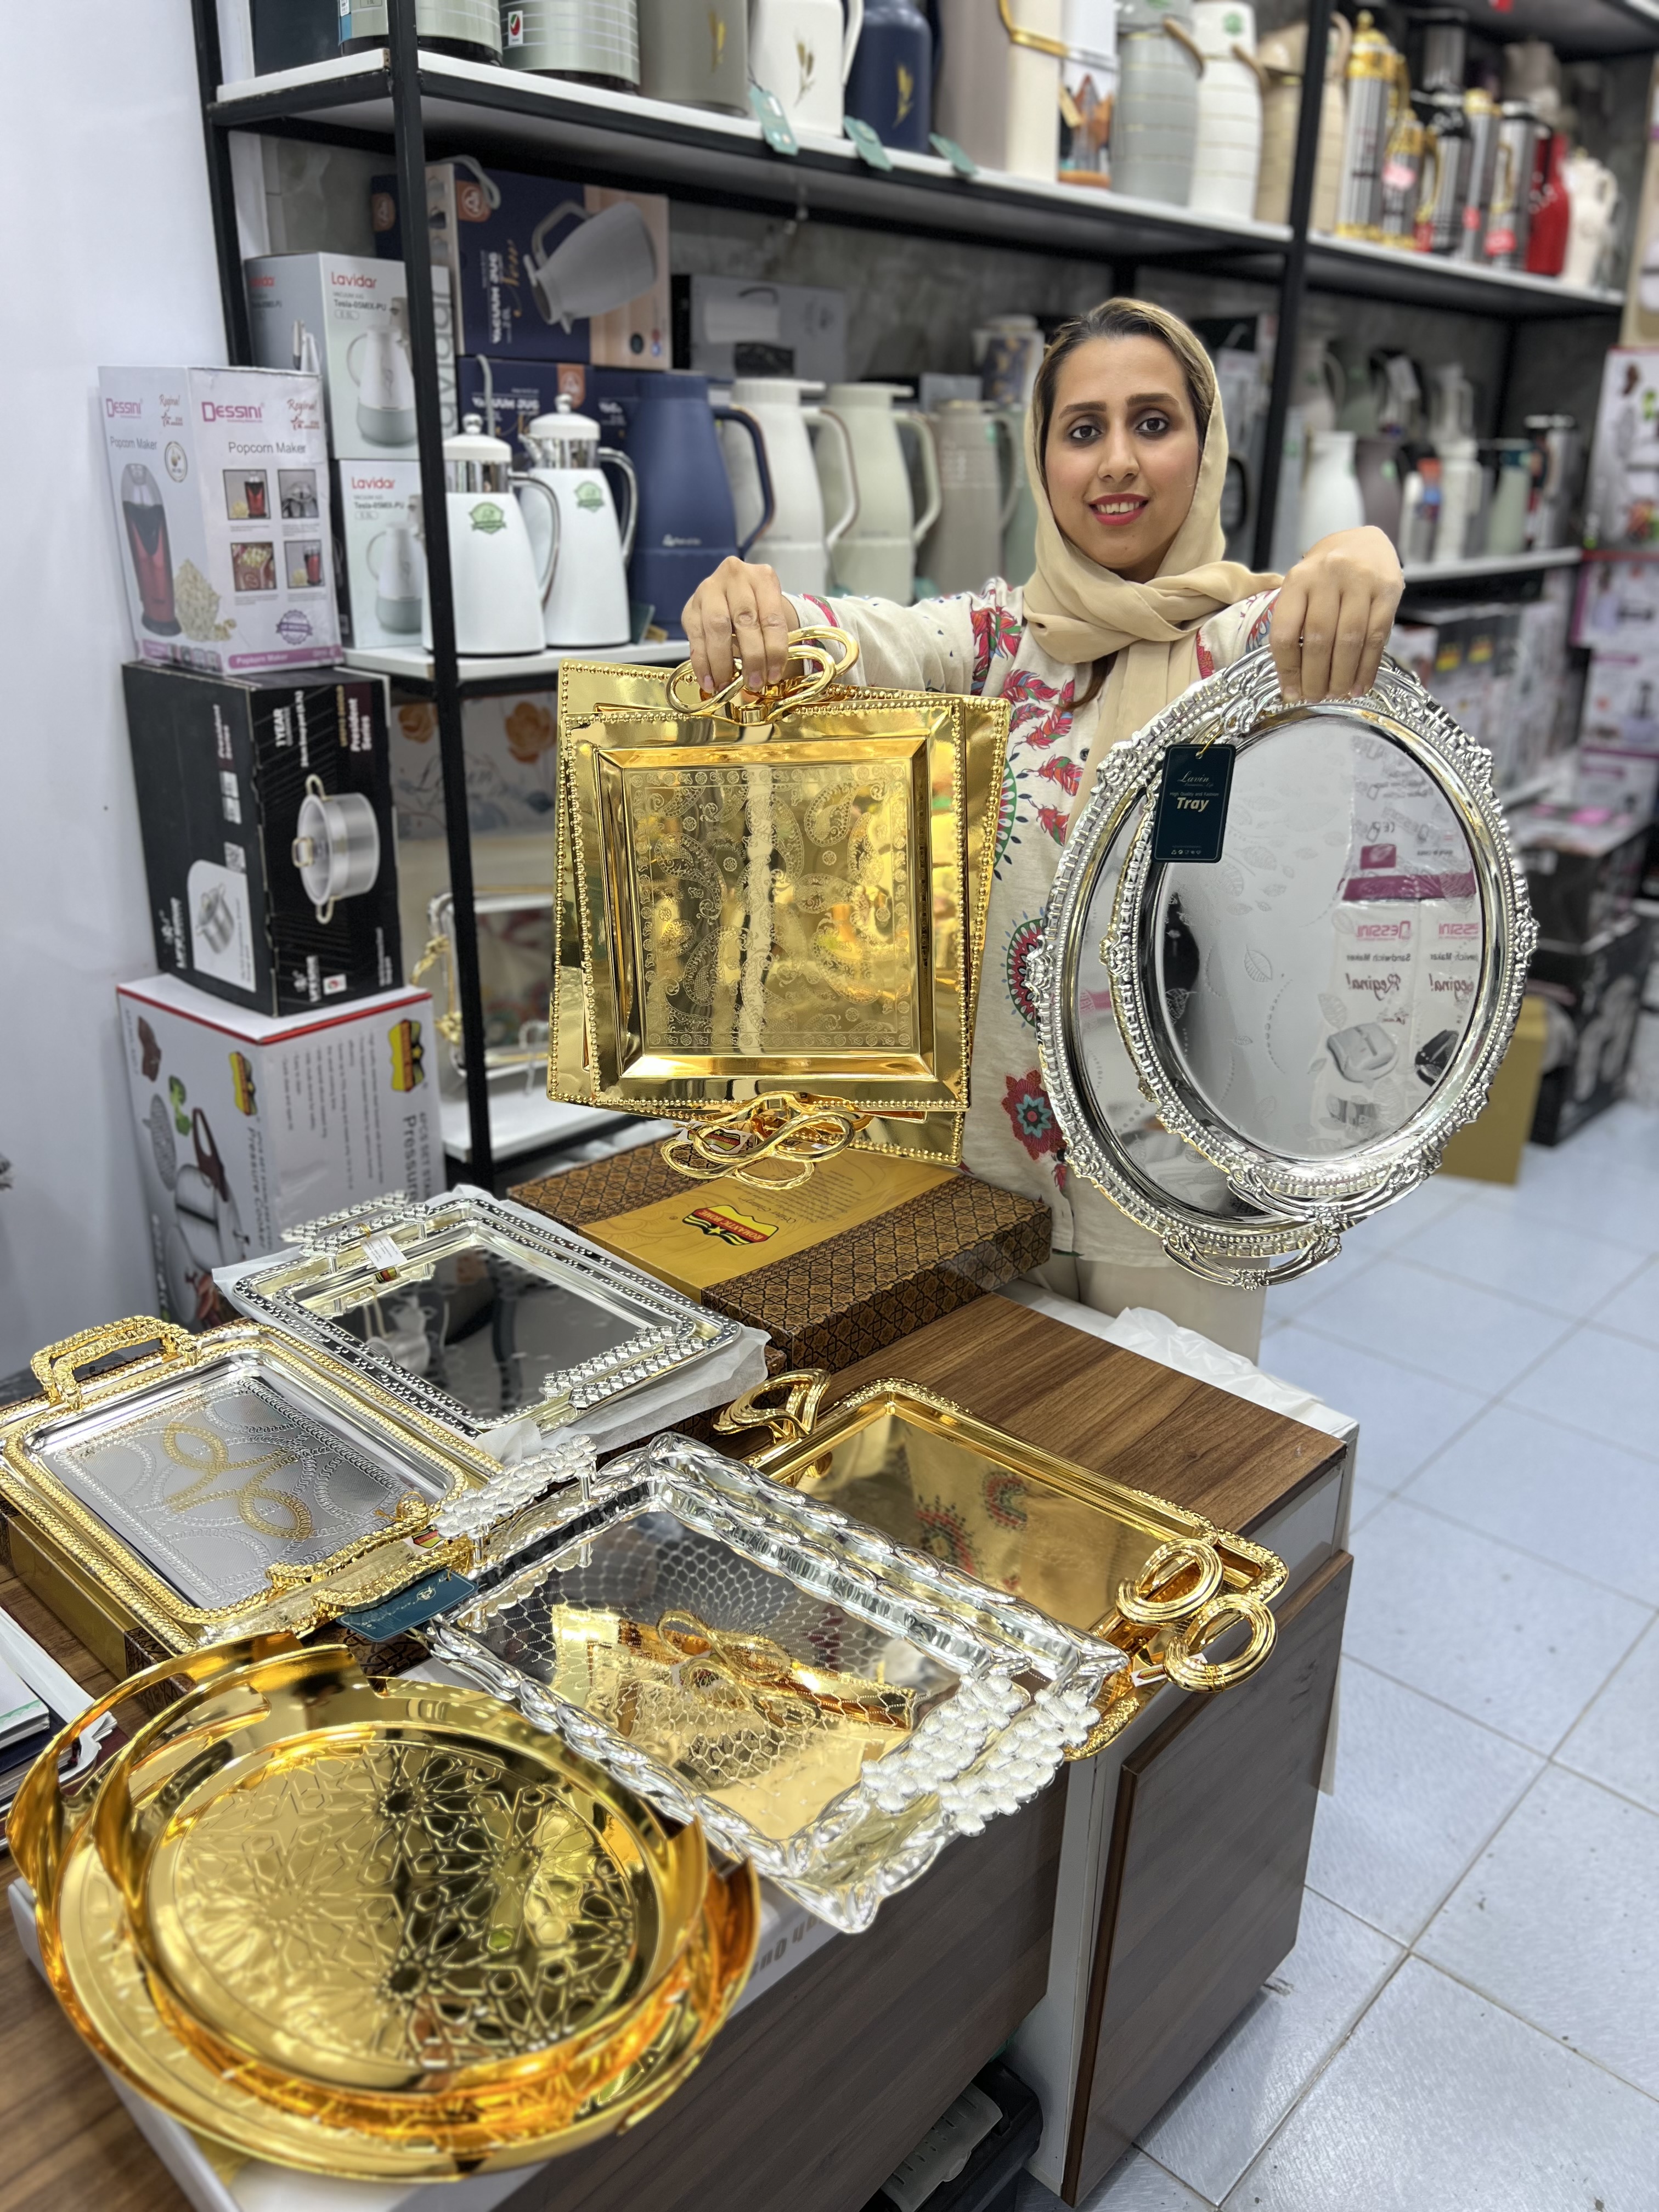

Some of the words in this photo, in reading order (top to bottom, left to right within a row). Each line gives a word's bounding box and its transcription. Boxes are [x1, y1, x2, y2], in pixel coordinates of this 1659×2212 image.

[331, 272, 377, 289] Lavidar
[110, 436, 136, 449] Popcorn
[137, 438, 157, 450] Maker
[229, 442, 274, 455] Popcorn
[276, 442, 306, 454] Maker
[351, 477, 396, 490] Lavidar
[348, 698, 361, 752] President
[360, 715, 372, 751] Series
[1177, 771, 1210, 783] Lavin
[1177, 797, 1209, 812] Tray
[403, 1115, 418, 1203] Pressure
[247, 1126, 261, 1193] Pressure
[254, 1197, 267, 1250] Cooker
[698, 1210, 721, 1222] HOME
[721, 1220, 764, 1240] ROMANTIC
